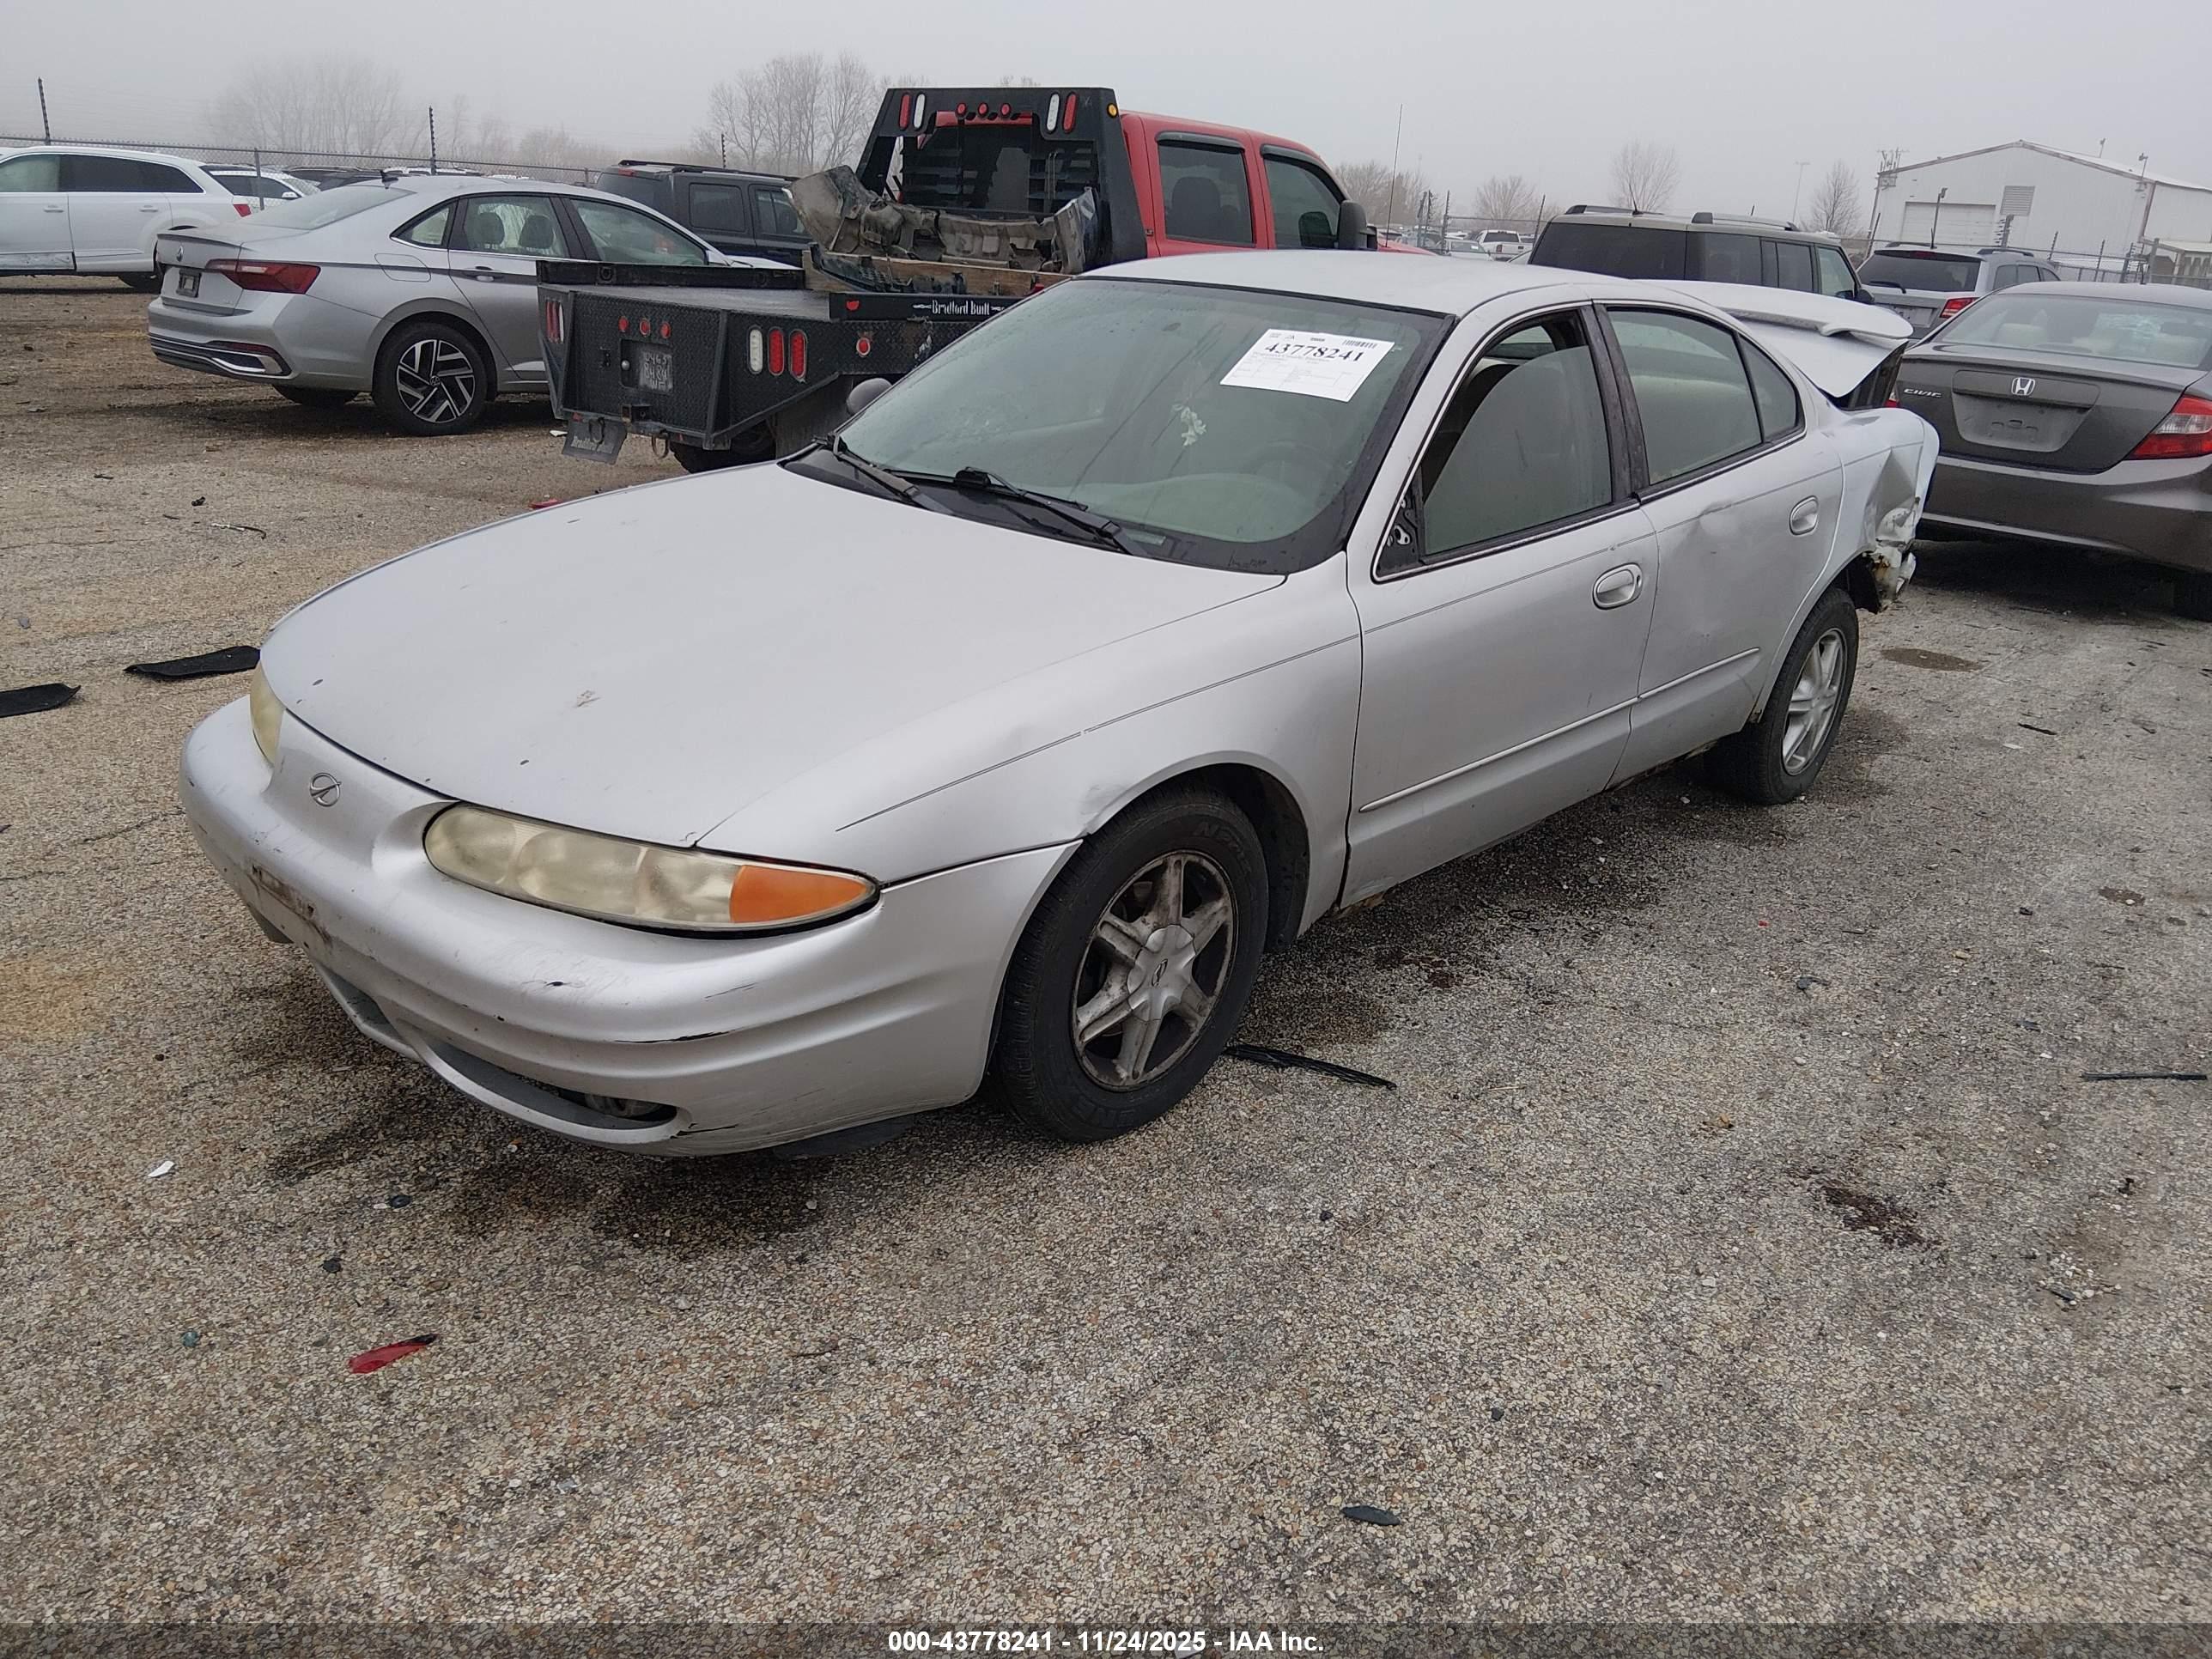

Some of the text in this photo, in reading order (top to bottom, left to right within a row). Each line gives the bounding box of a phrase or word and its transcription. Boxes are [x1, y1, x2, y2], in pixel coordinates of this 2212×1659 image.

[932, 299, 990, 315] Bradford Built
[1264, 342, 1365, 362] 43778241
[1904, 388, 1942, 398] CIVIC
